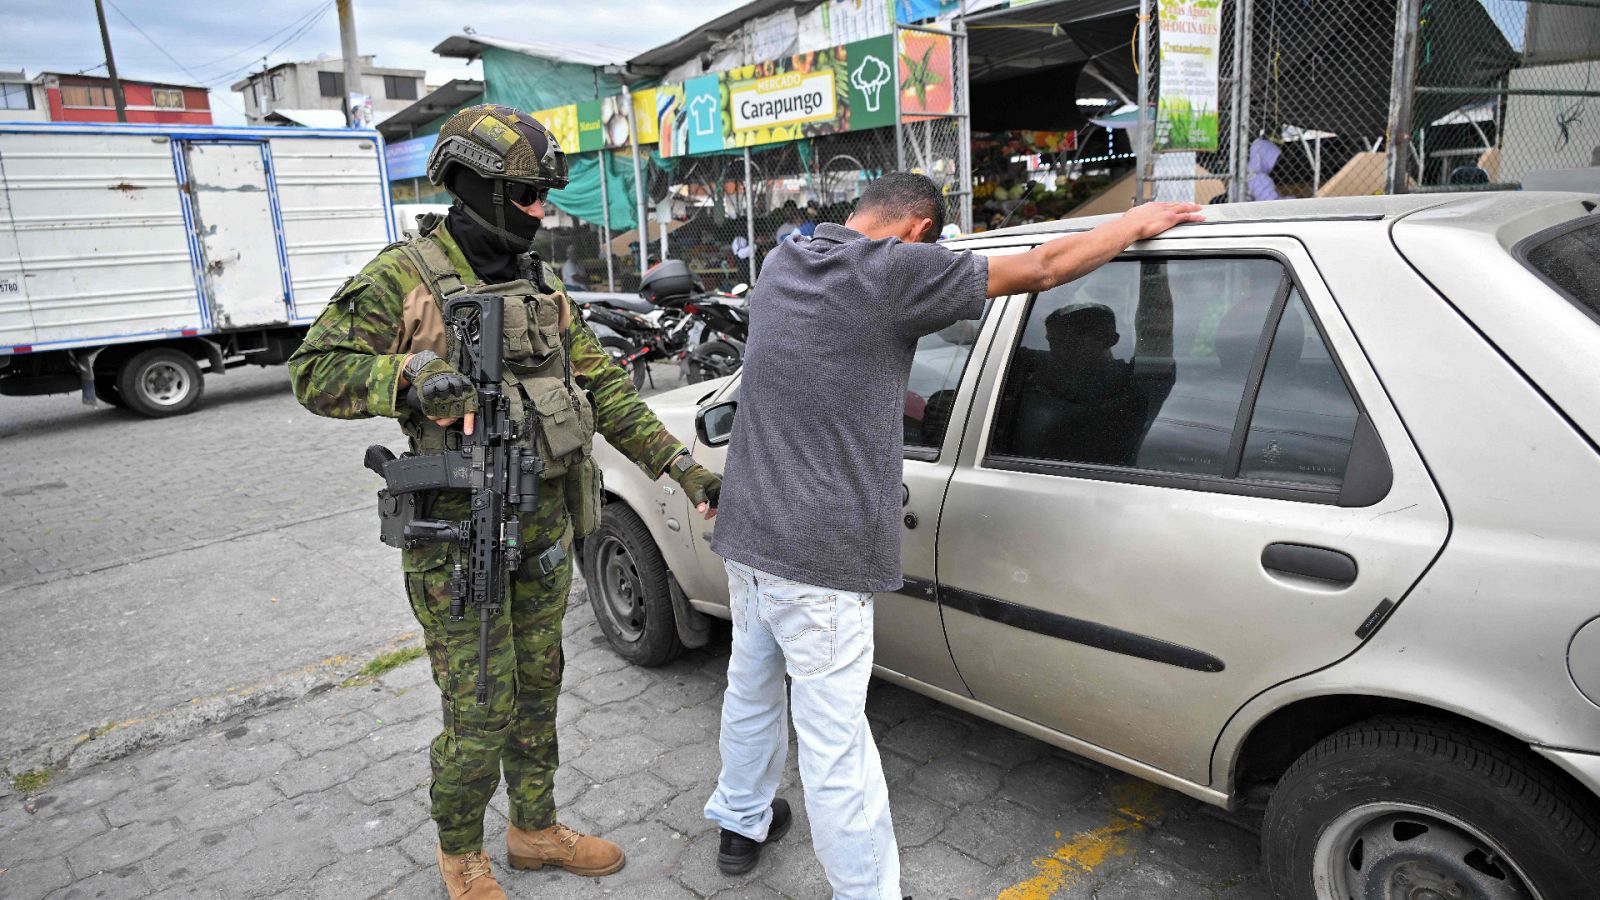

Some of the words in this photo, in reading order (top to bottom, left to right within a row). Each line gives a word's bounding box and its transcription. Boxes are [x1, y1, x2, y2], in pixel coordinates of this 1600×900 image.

[1159, 20, 1218, 35] MEDICINALES
[757, 73, 801, 91] MERCADO
[741, 91, 823, 120] Carapungo
